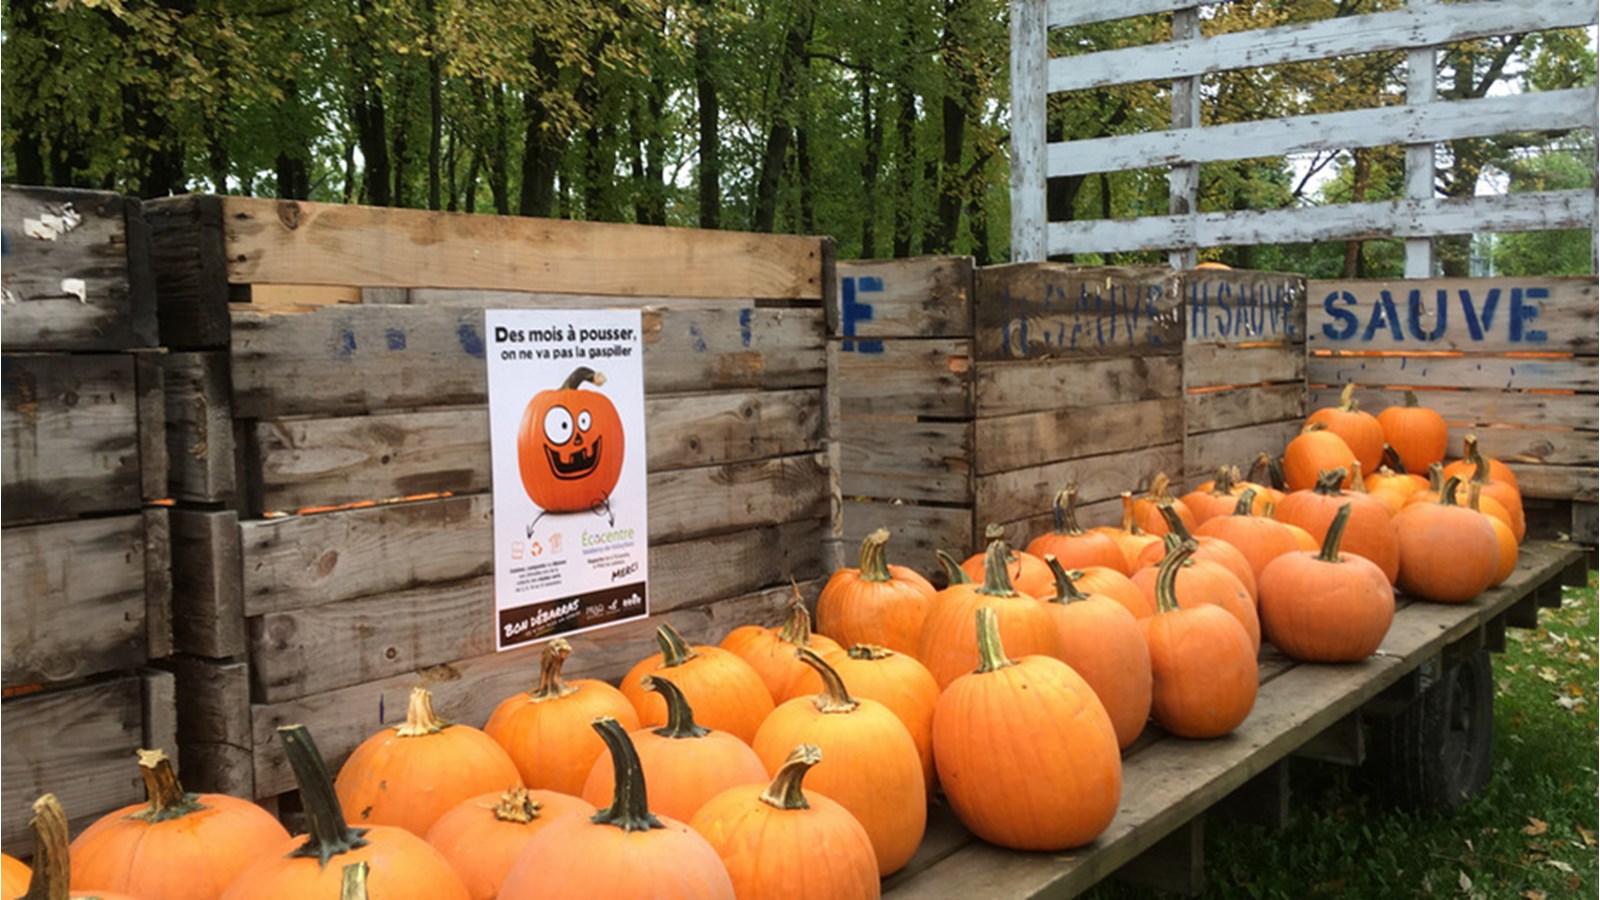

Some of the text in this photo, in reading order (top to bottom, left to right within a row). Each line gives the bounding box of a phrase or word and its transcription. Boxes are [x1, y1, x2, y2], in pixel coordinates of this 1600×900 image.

[494, 326, 525, 343] Des
[528, 325, 564, 342] mois
[566, 324, 577, 342] à
[500, 345, 633, 361] on ne va pas la gaspiller
[611, 562, 639, 582] MERCI
[503, 622, 529, 638] BON
[530, 598, 581, 628] DÉBARRAS
